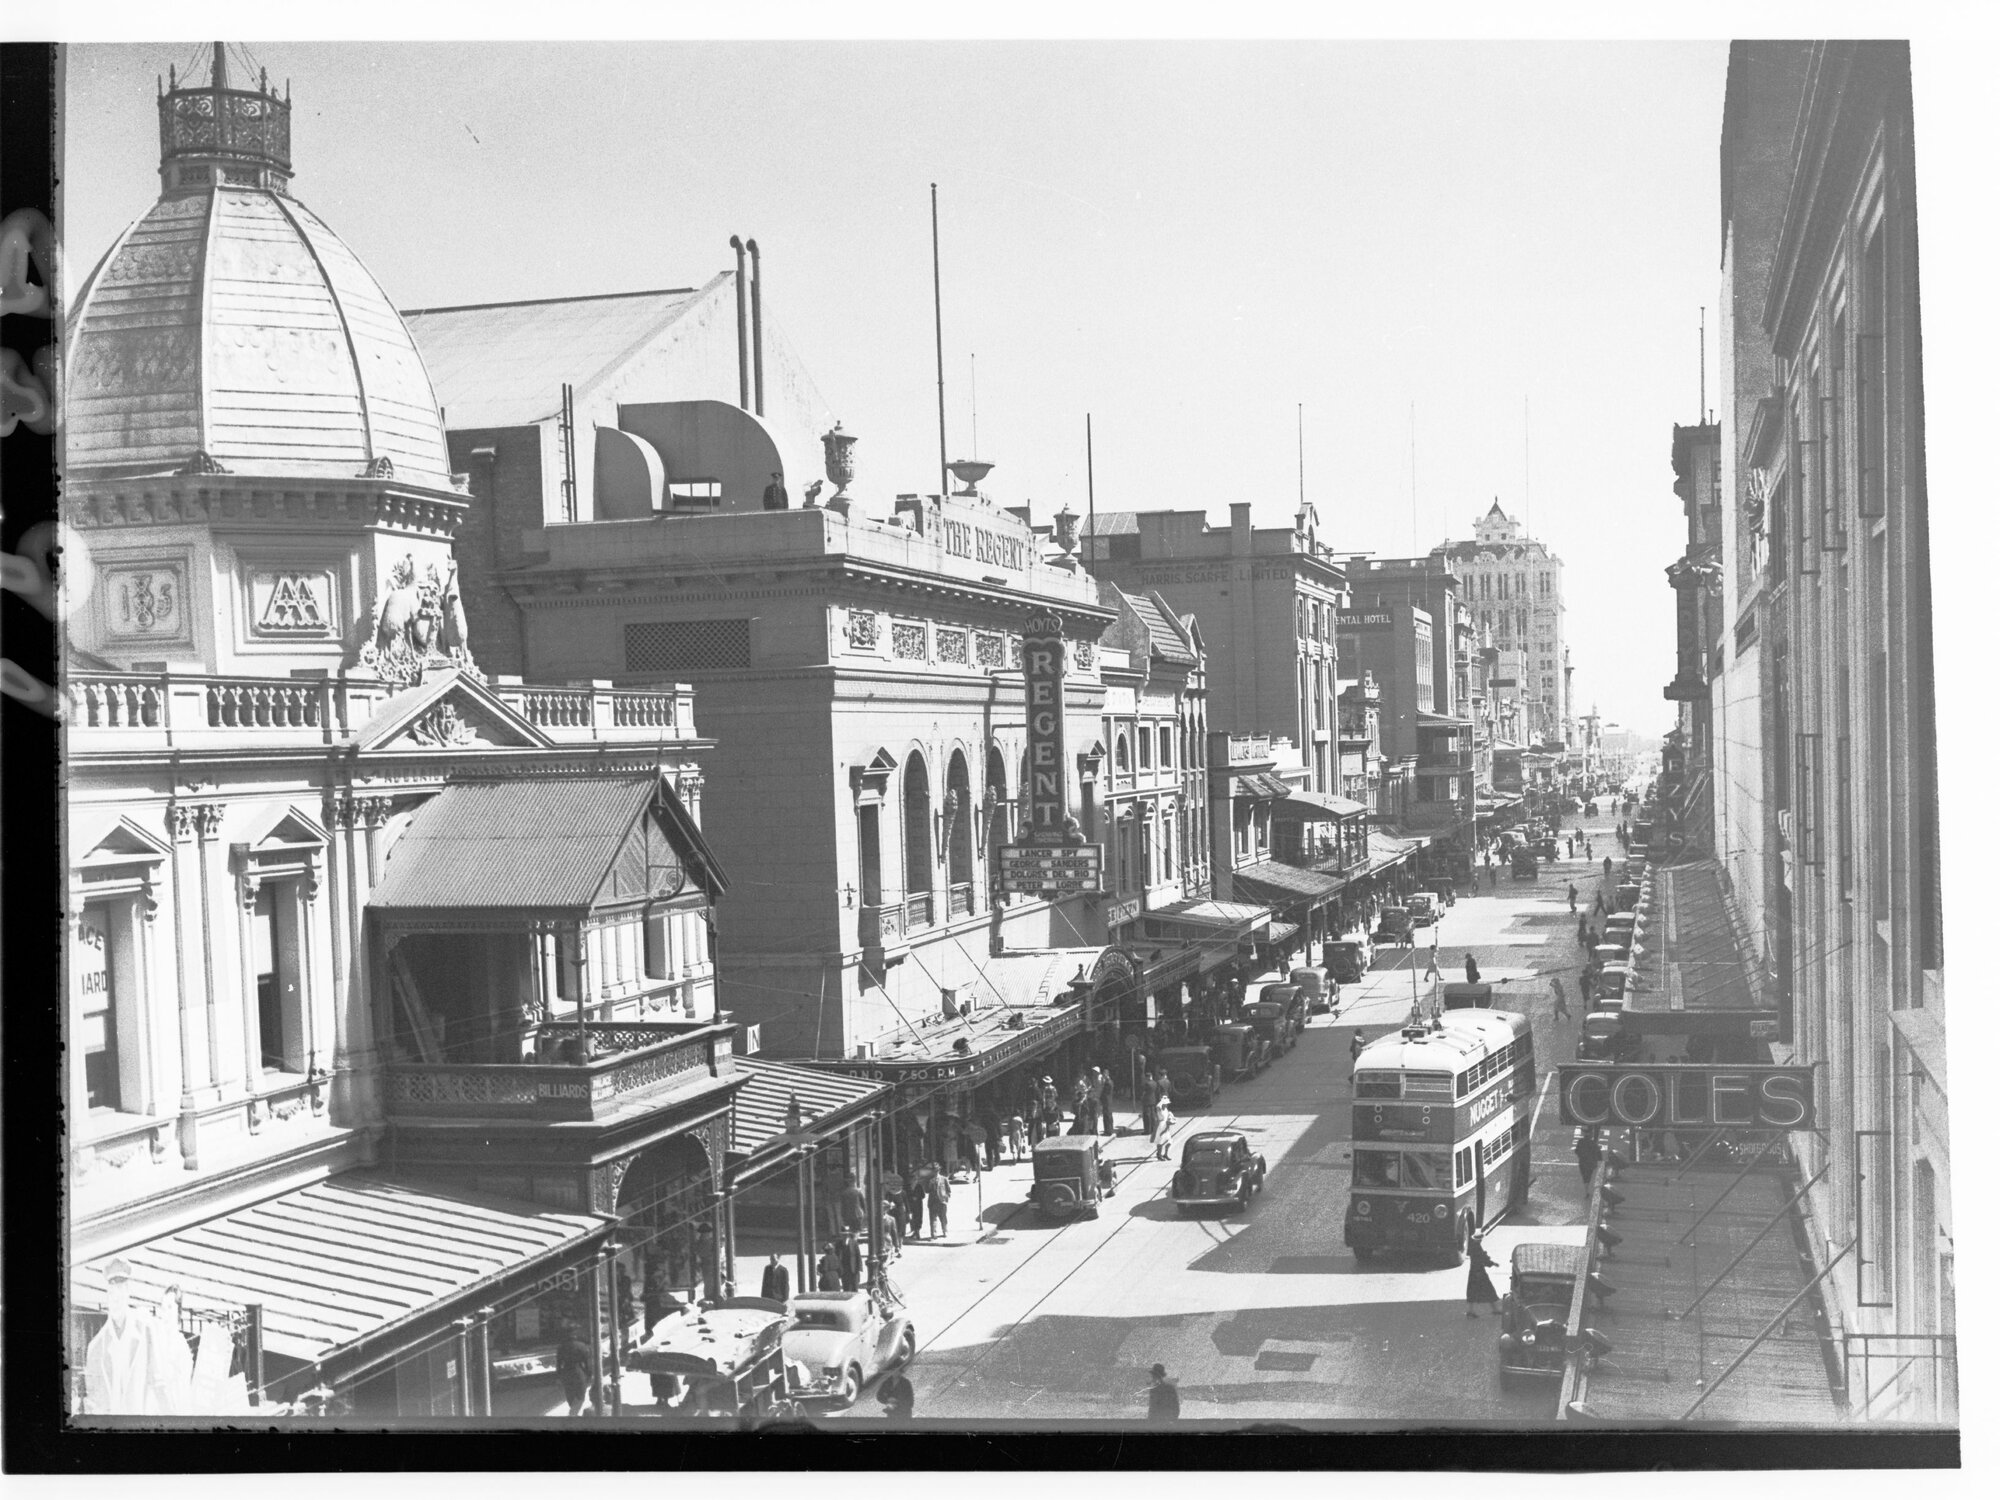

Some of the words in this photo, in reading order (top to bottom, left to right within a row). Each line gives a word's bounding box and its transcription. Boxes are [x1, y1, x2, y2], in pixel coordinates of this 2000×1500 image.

[943, 517, 971, 560] THE
[975, 526, 1024, 572] REGENT
[1185, 570, 1229, 584] SCARFE
[1024, 617, 1060, 634] HOYTS
[1364, 614, 1391, 624] HOTEL
[1031, 650, 1060, 826] REGENT
[1019, 849, 1053, 858] LANCER
[1061, 849, 1078, 858] SPY
[1051, 860, 1089, 868] SANDERS
[1052, 870, 1069, 878] DEL
[1074, 870, 1090, 878] RIO
[1016, 881, 1043, 890] PETER
[538, 1083, 588, 1099] BILLIARDS
[1565, 1072, 1805, 1125] COLES
[1469, 1089, 1499, 1127] NUGGET
[1408, 1212, 1430, 1224] 420
